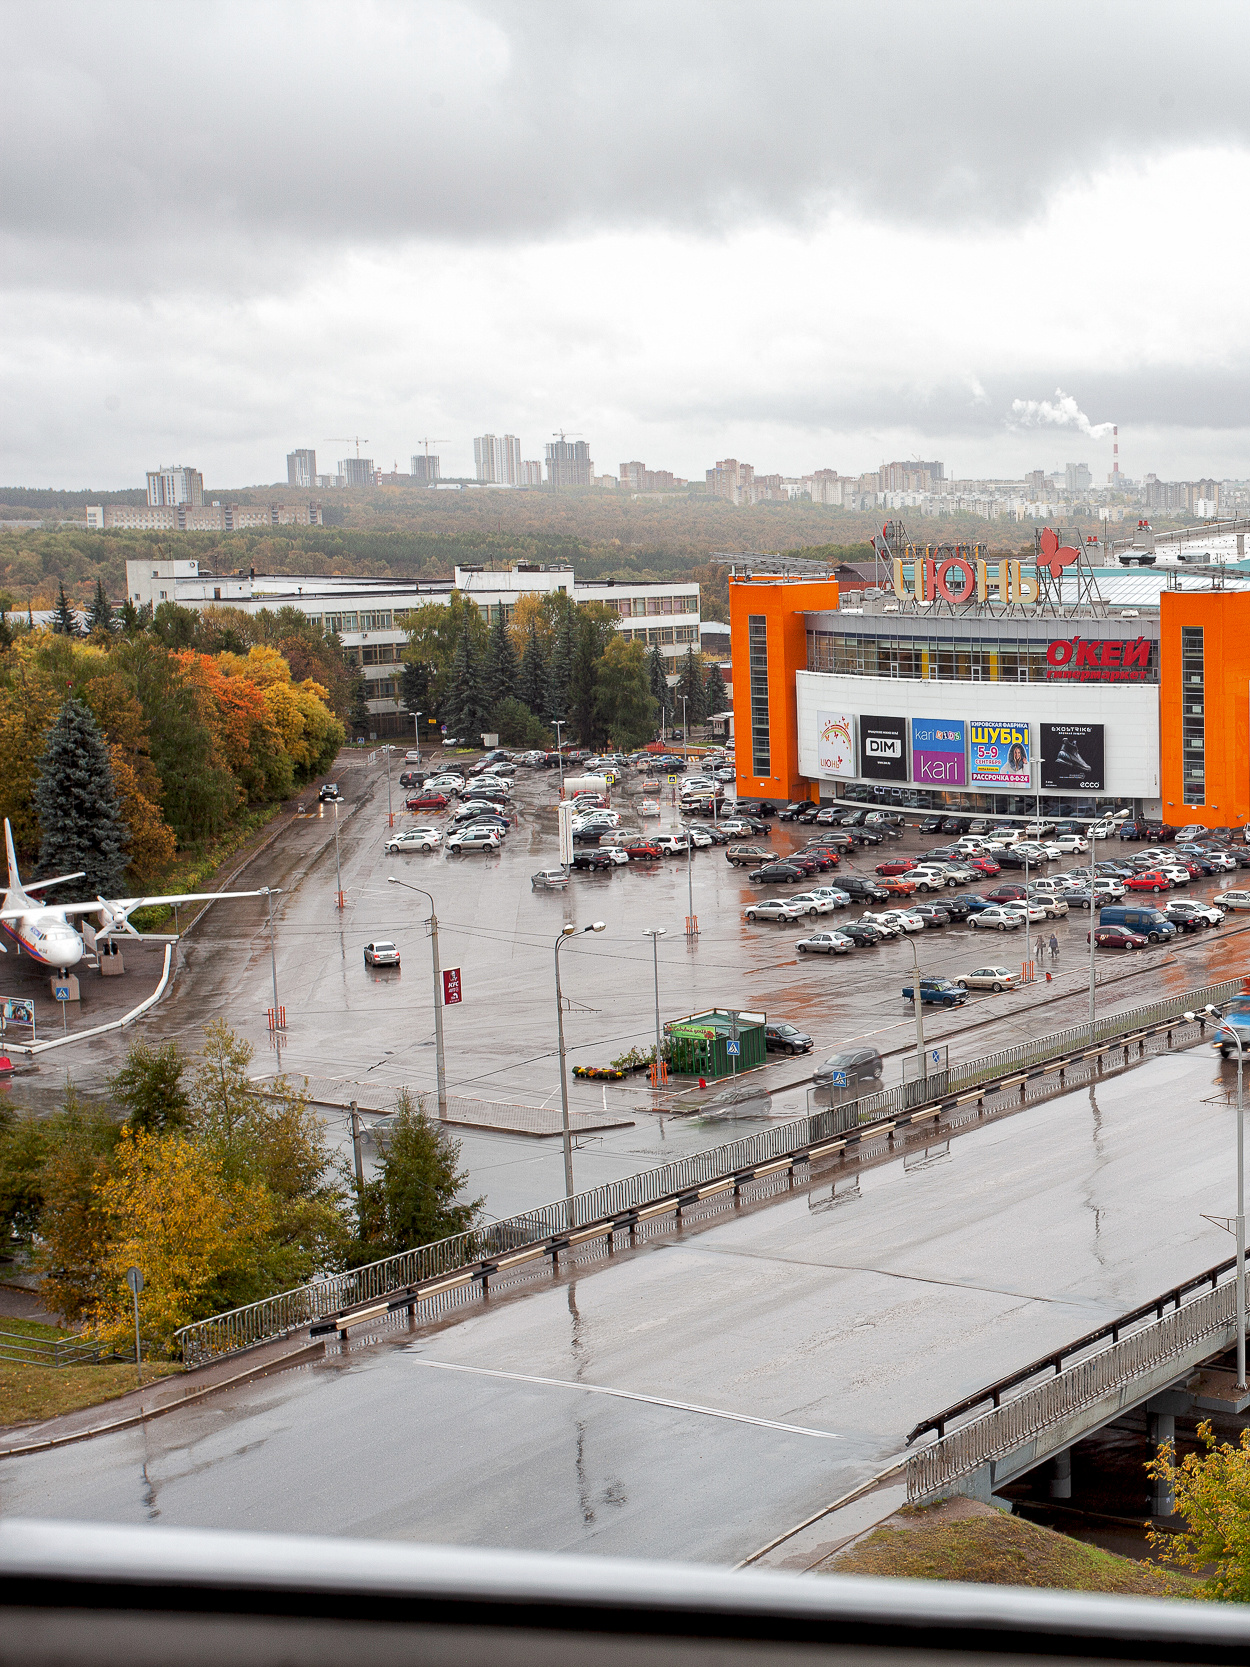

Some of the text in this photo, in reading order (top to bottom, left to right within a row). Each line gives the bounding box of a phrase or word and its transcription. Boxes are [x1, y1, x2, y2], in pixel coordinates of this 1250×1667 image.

[1046, 669, 1148, 682] гипермаркет
[915, 728, 935, 741] kari
[971, 727, 1028, 745] ШУБЫ
[870, 740, 895, 753] DIM
[978, 746, 998, 758] 5-9
[921, 755, 957, 780] kari
[973, 773, 1009, 781] РАССРОЧКА
